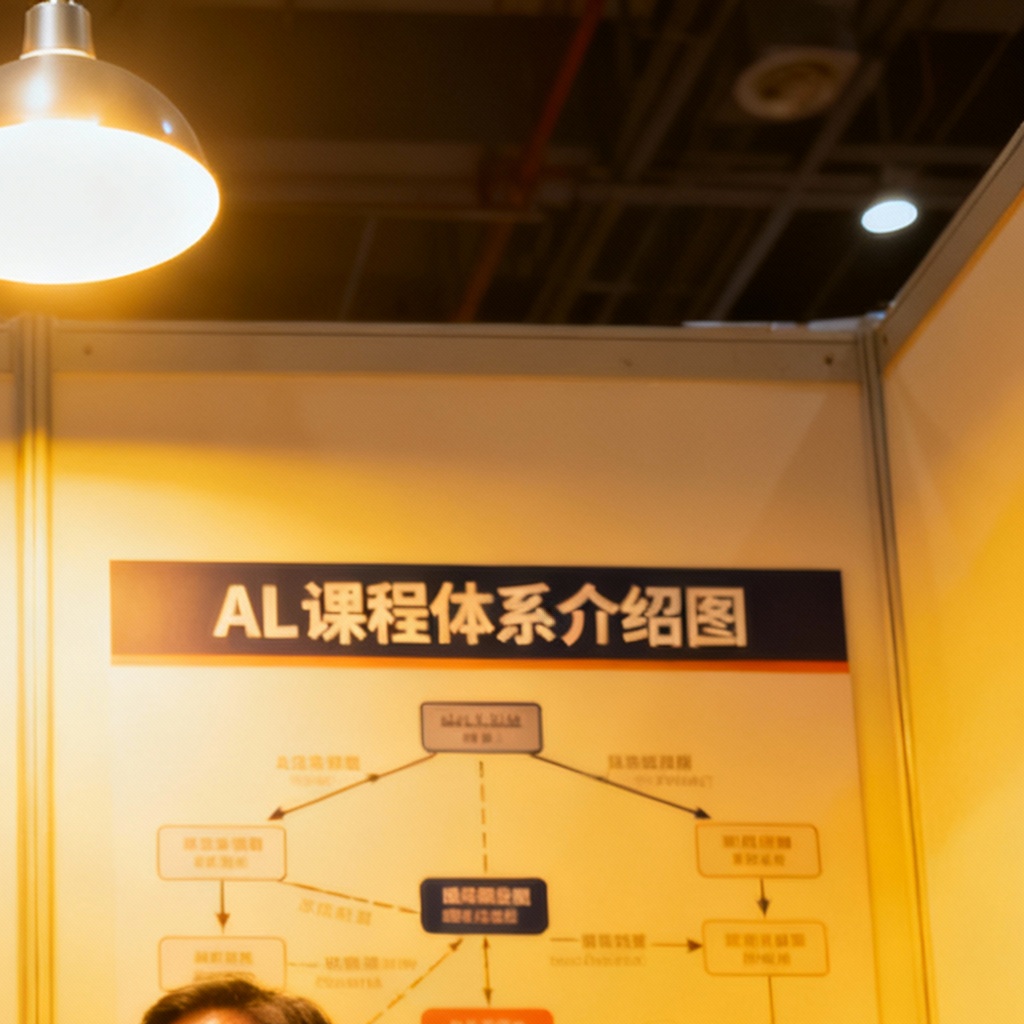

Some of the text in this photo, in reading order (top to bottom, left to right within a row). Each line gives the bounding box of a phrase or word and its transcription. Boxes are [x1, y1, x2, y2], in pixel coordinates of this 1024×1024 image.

[213, 580, 748, 648] AL课程体系介绍图
